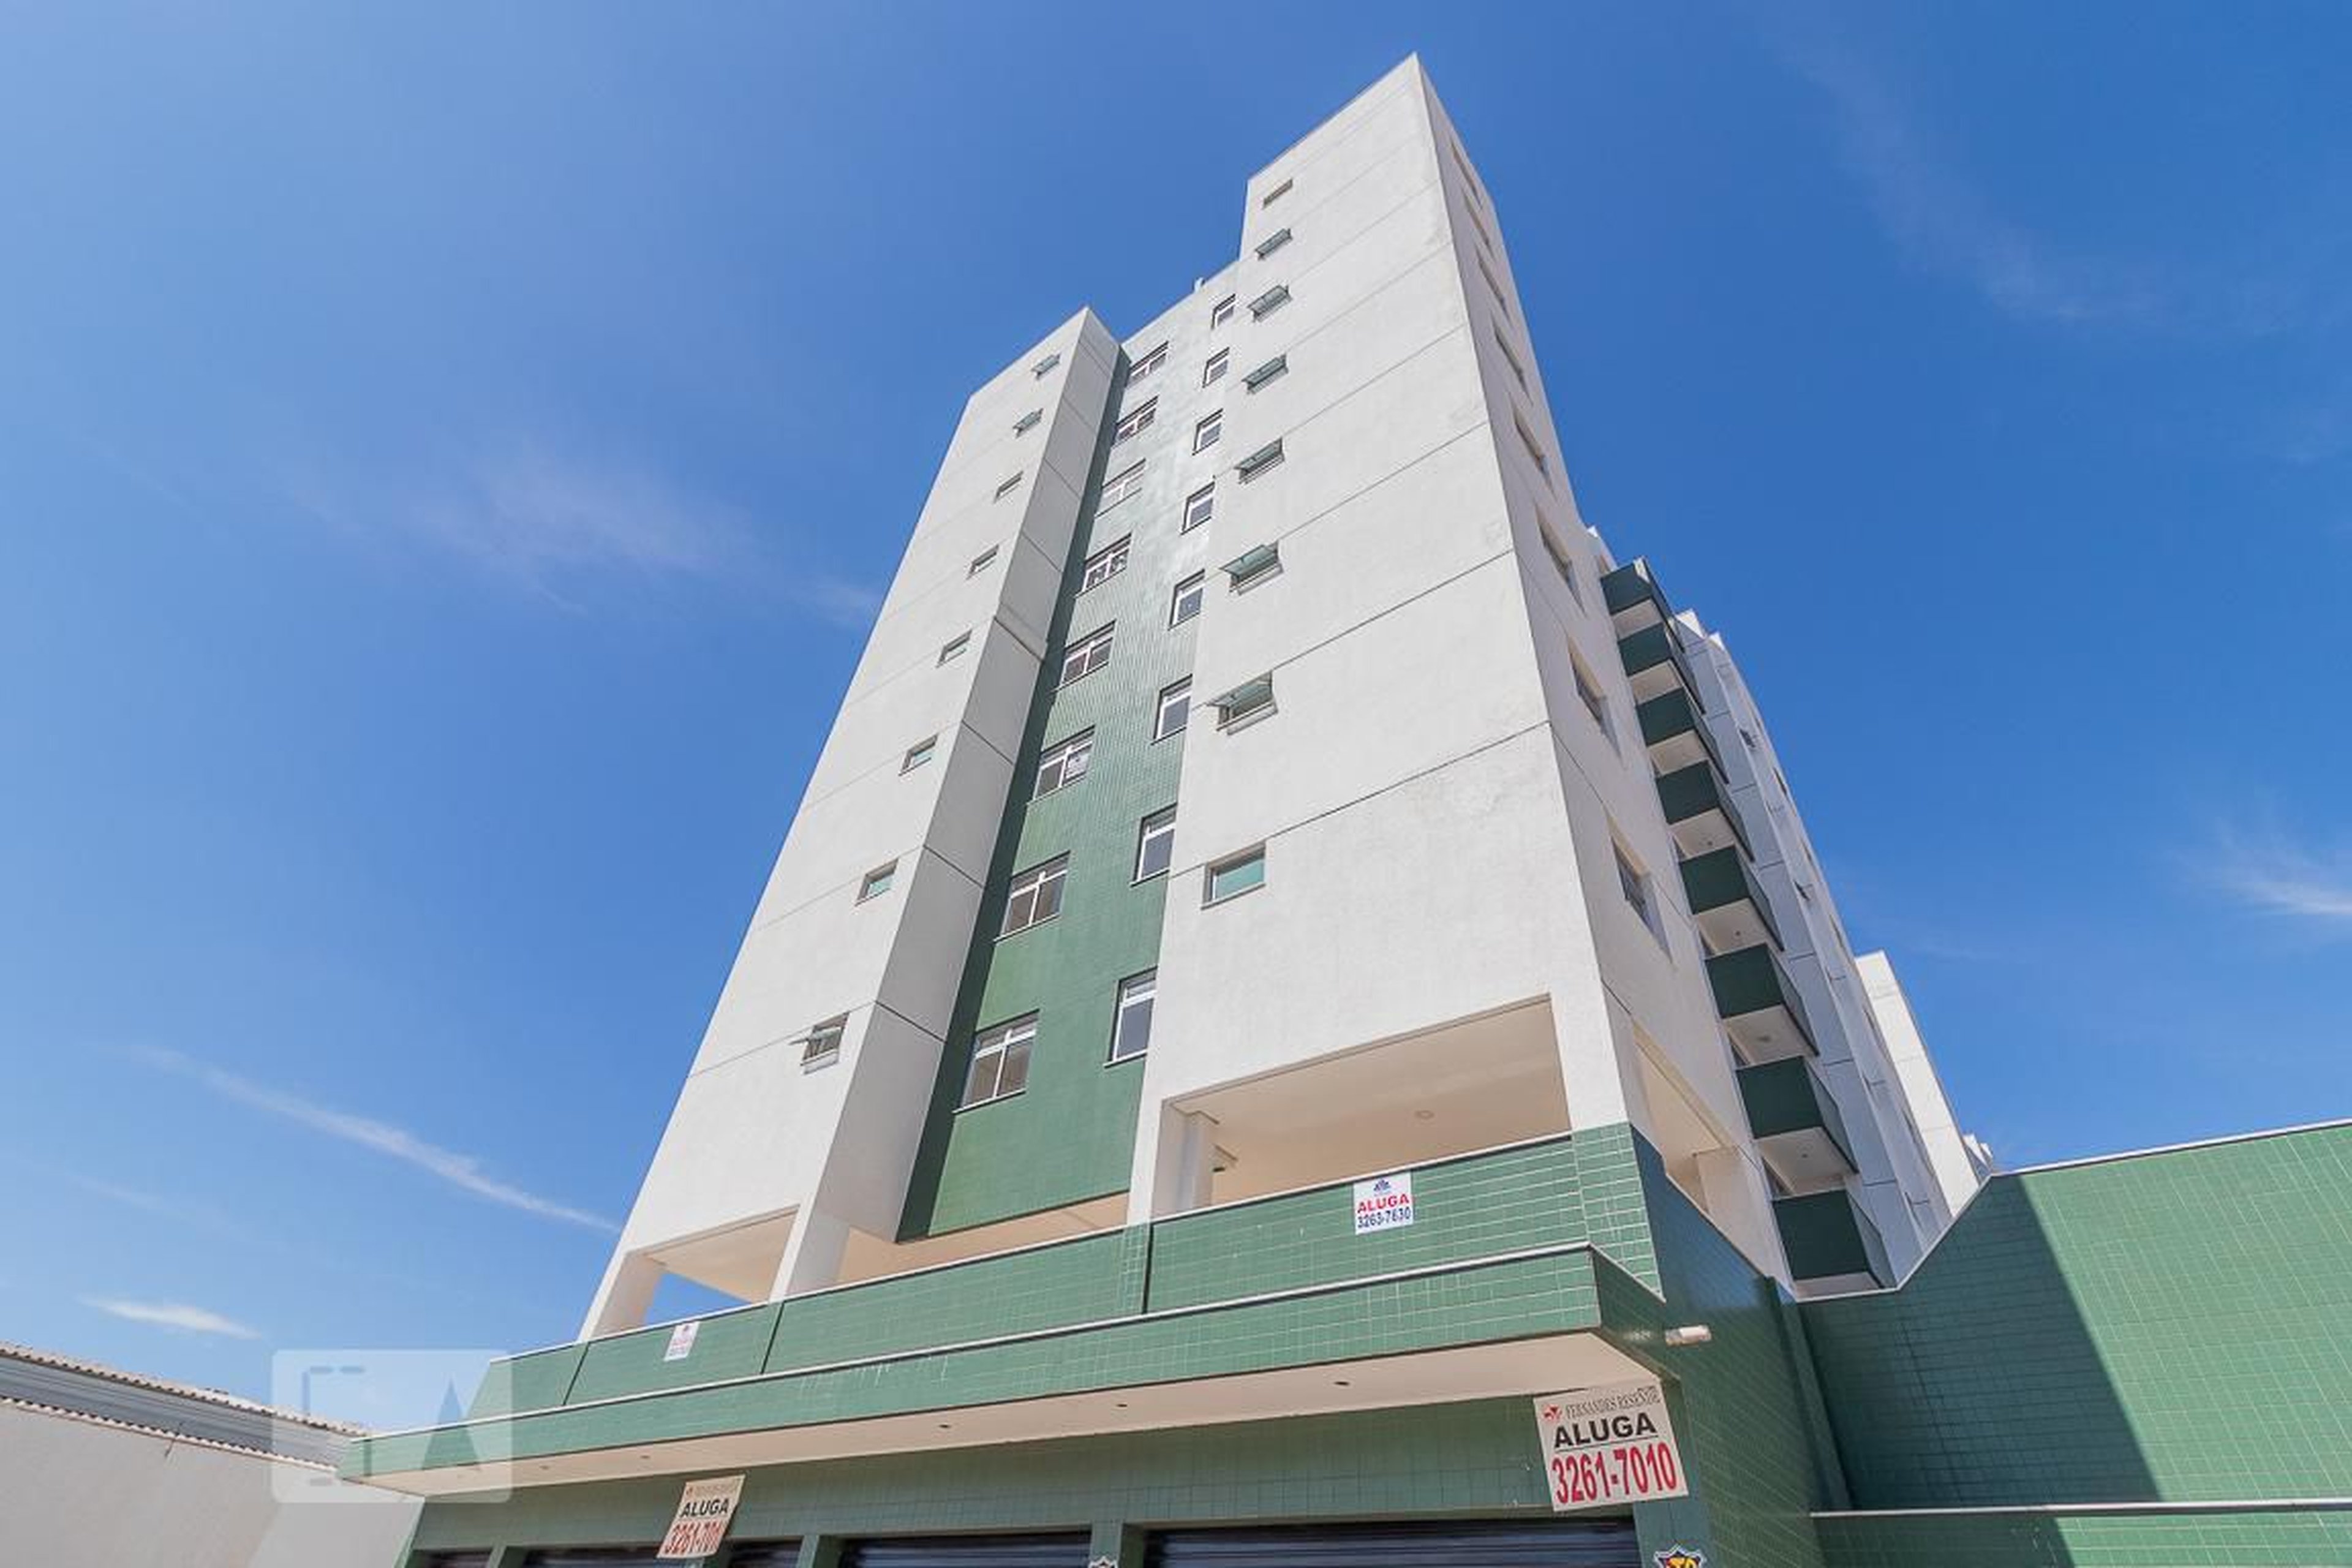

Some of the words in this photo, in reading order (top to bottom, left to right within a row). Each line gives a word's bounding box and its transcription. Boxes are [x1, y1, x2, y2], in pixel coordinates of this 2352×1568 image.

[1357, 1193, 1409, 1214] ALUGA
[1555, 1412, 1657, 1449] ALUGA
[1551, 1441, 1678, 1504] 3261-7010
[680, 1498, 729, 1518] ALUGA
